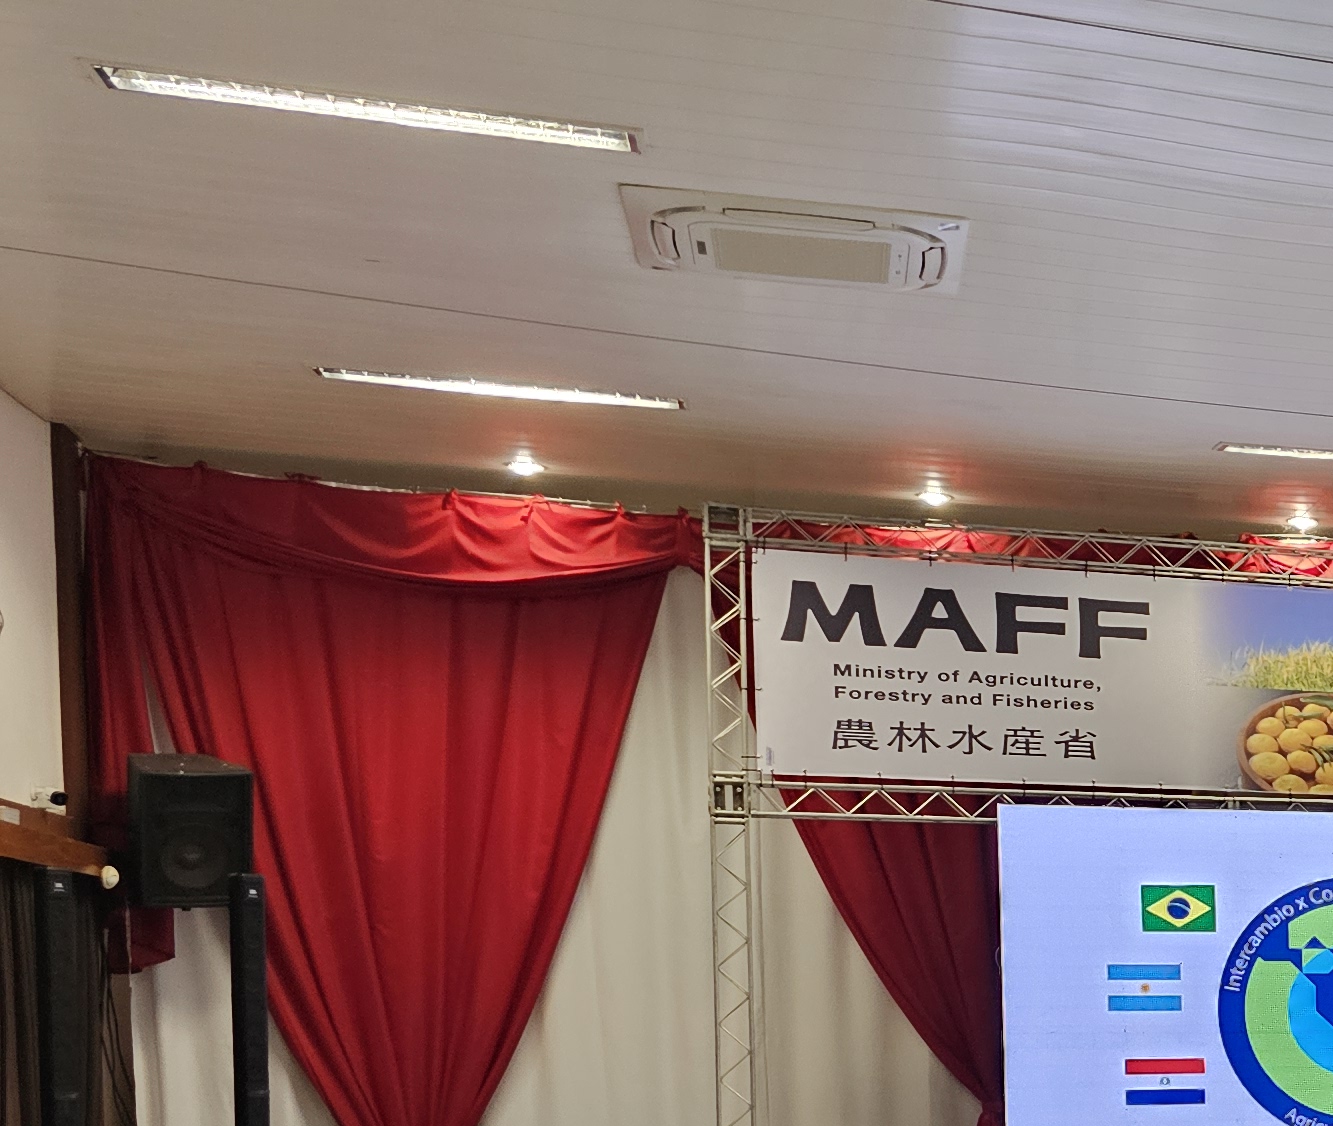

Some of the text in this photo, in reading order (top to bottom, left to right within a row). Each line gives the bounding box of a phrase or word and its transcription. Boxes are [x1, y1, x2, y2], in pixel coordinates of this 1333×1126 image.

[780, 579, 1150, 659] MAFF
[833, 663, 1102, 693] Ministry of Agriculture,
[834, 685, 1095, 711] Forestry and Fisheries
[831, 718, 1098, 761] 農林水産省
[1224, 902, 1295, 992] Intercambio
[1298, 896, 1309, 911] x
